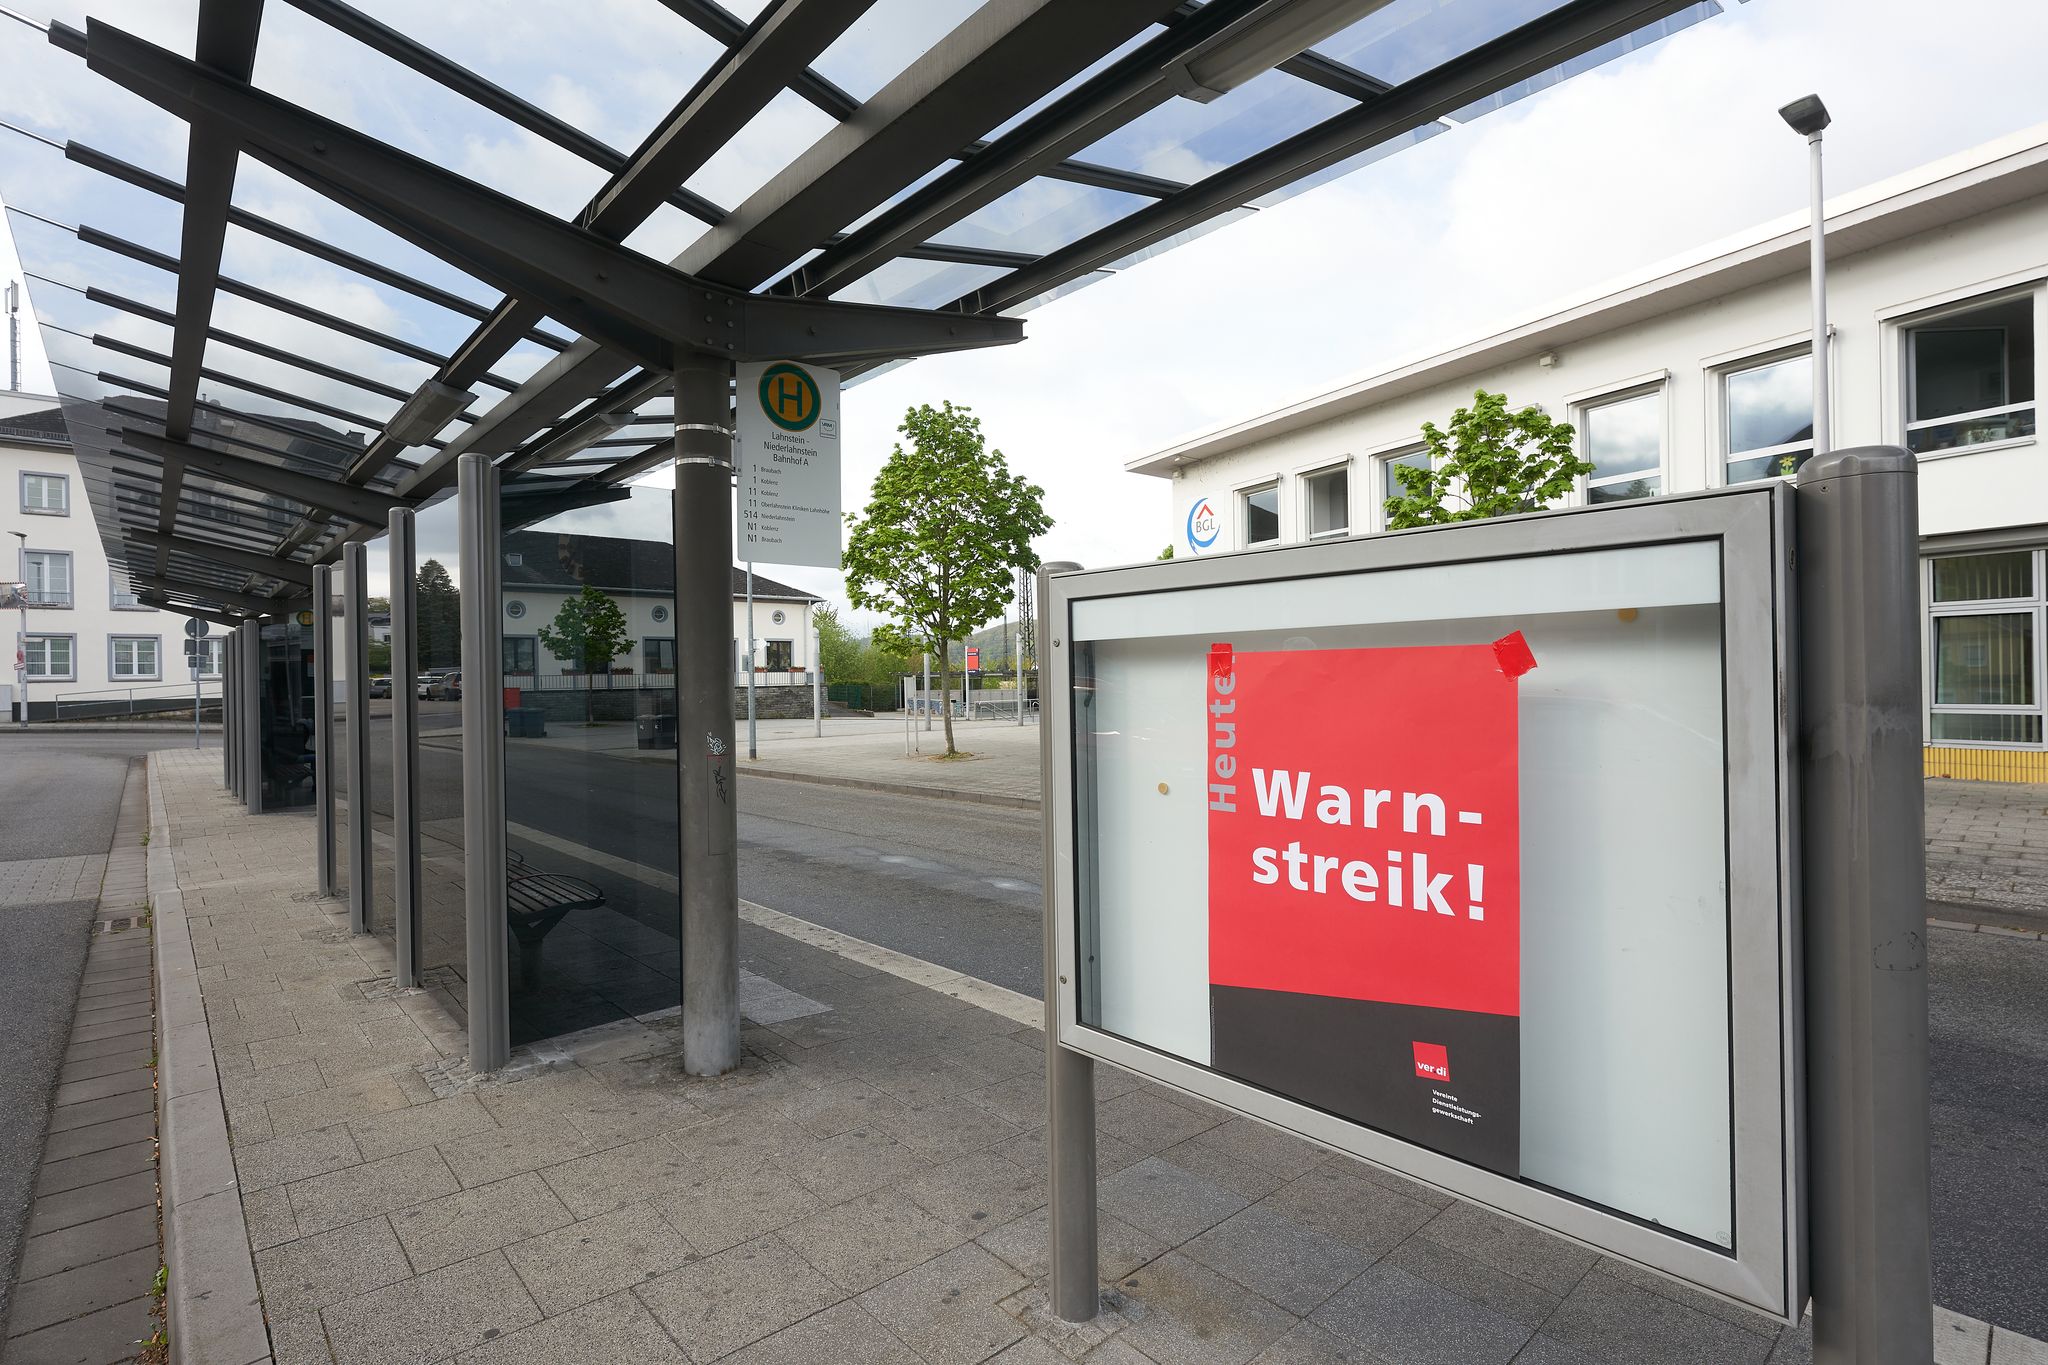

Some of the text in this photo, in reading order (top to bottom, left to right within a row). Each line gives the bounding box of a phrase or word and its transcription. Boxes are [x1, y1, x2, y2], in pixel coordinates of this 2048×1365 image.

[778, 377, 803, 417] H
[771, 431, 805, 445] Lahnstein
[763, 441, 818, 457] Niederlahnstein
[773, 454, 802, 466] Bahnhof
[753, 464, 782, 474] 1 Braubach
[753, 476, 757, 484] 1
[749, 487, 757, 495] 11
[749, 499, 757, 507] 11
[761, 502, 792, 511] Oberlahnstein
[761, 514, 796, 523] Niederlahnstein
[747, 522, 757, 531] N1
[1195, 518, 1216, 533] BGL
[747, 534, 757, 543] N1
[1251, 768, 1483, 837] Warn-
[1252, 841, 1485, 921] streik!
[1432, 1089, 1458, 1102] Vereinte
[1432, 1098, 1482, 1118] Dienstleistungs-
[1432, 1107, 1474, 1125] gewerkschaft
